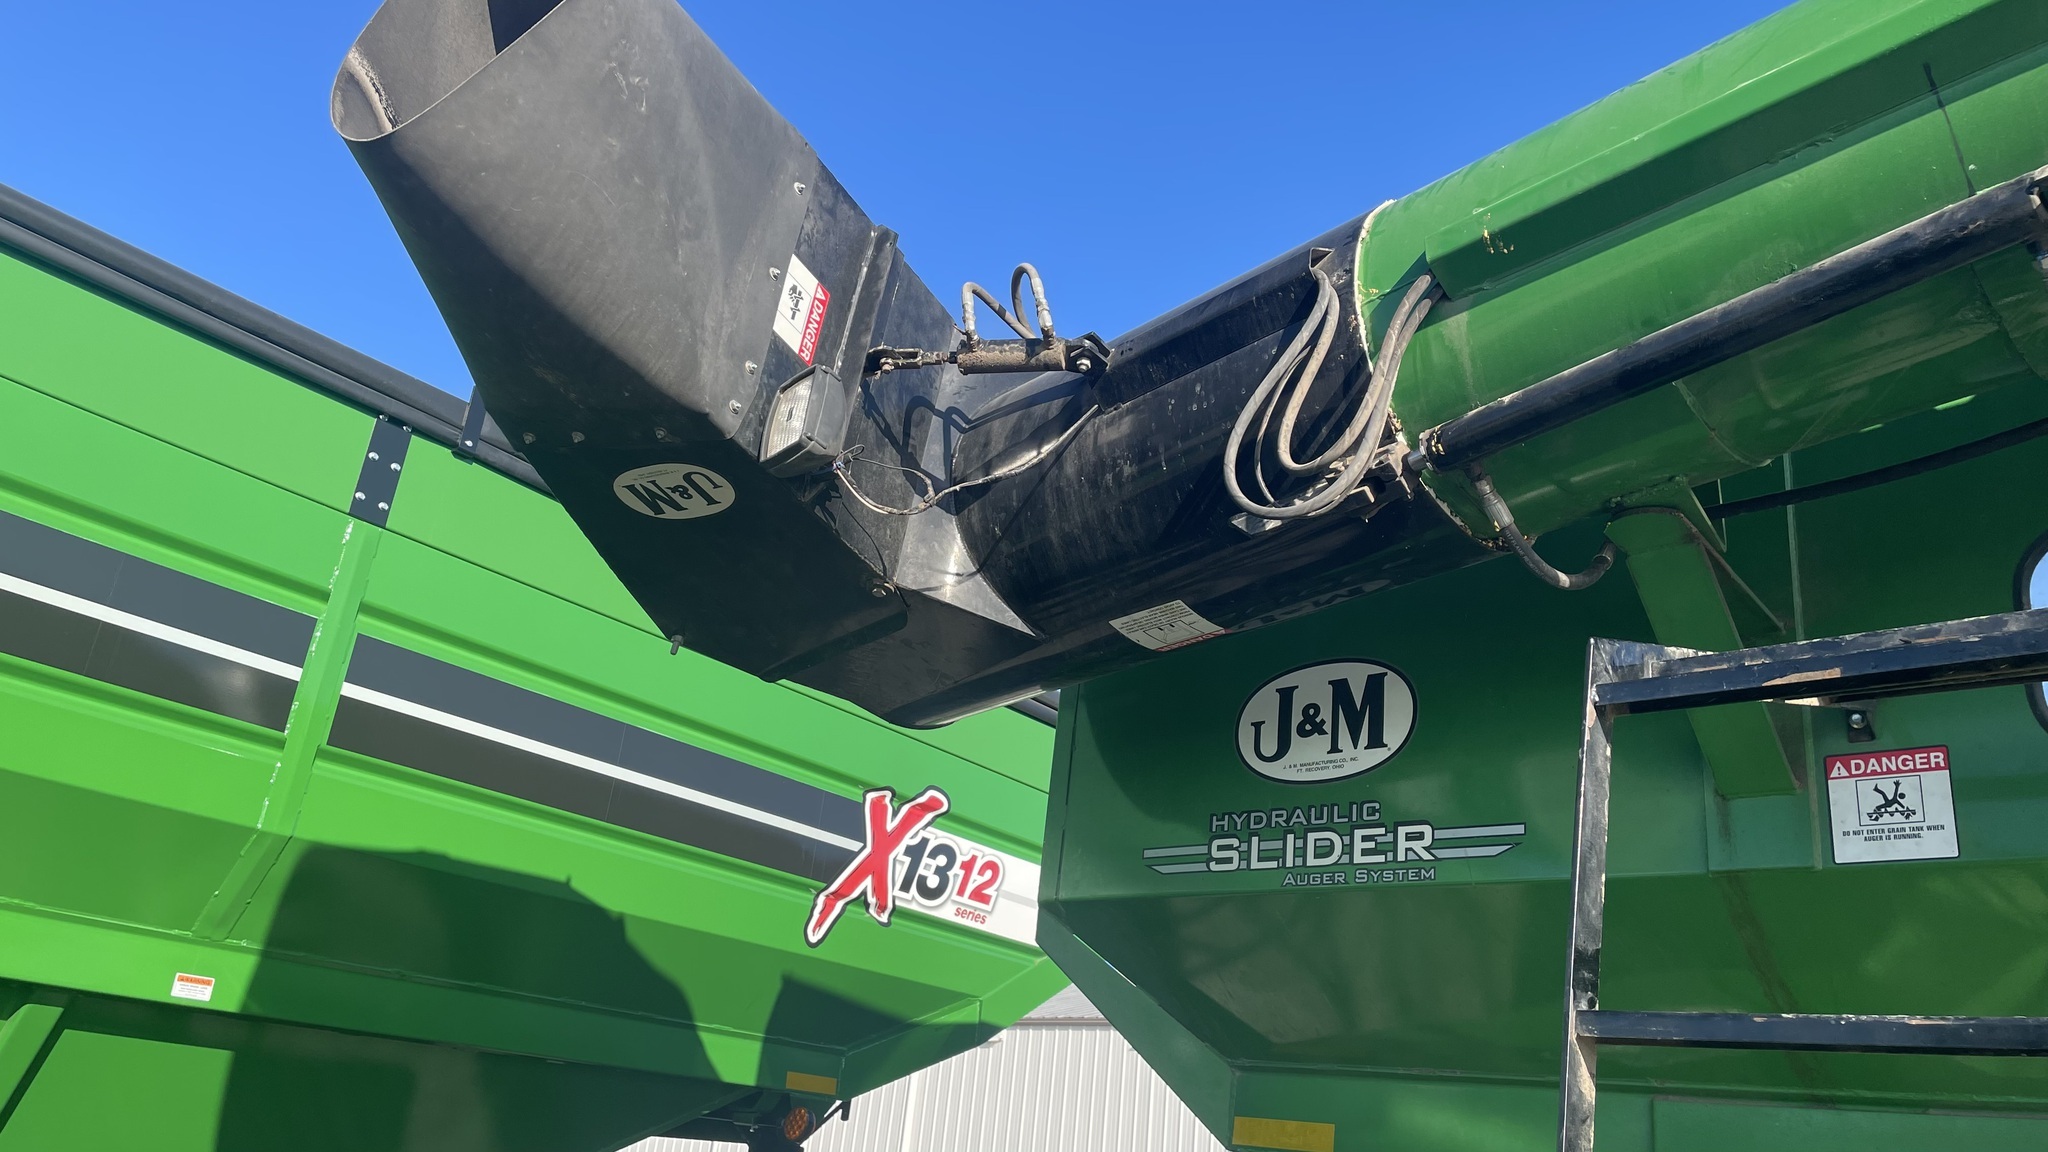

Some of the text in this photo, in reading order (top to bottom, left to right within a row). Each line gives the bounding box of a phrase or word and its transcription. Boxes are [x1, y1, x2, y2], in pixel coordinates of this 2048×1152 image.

[800, 297, 827, 364] DANGER
[621, 470, 723, 516] J&M
[1251, 672, 1388, 763] J&M
[1300, 758, 1338, 768] MANUFACTURING
[1850, 752, 1945, 775] DANGER
[1211, 801, 1381, 832] HYDRAULIC
[1208, 823, 1435, 872] SLIDER
[1282, 867, 1436, 886] AUGER SYSTEM
[954, 906, 987, 925] series
